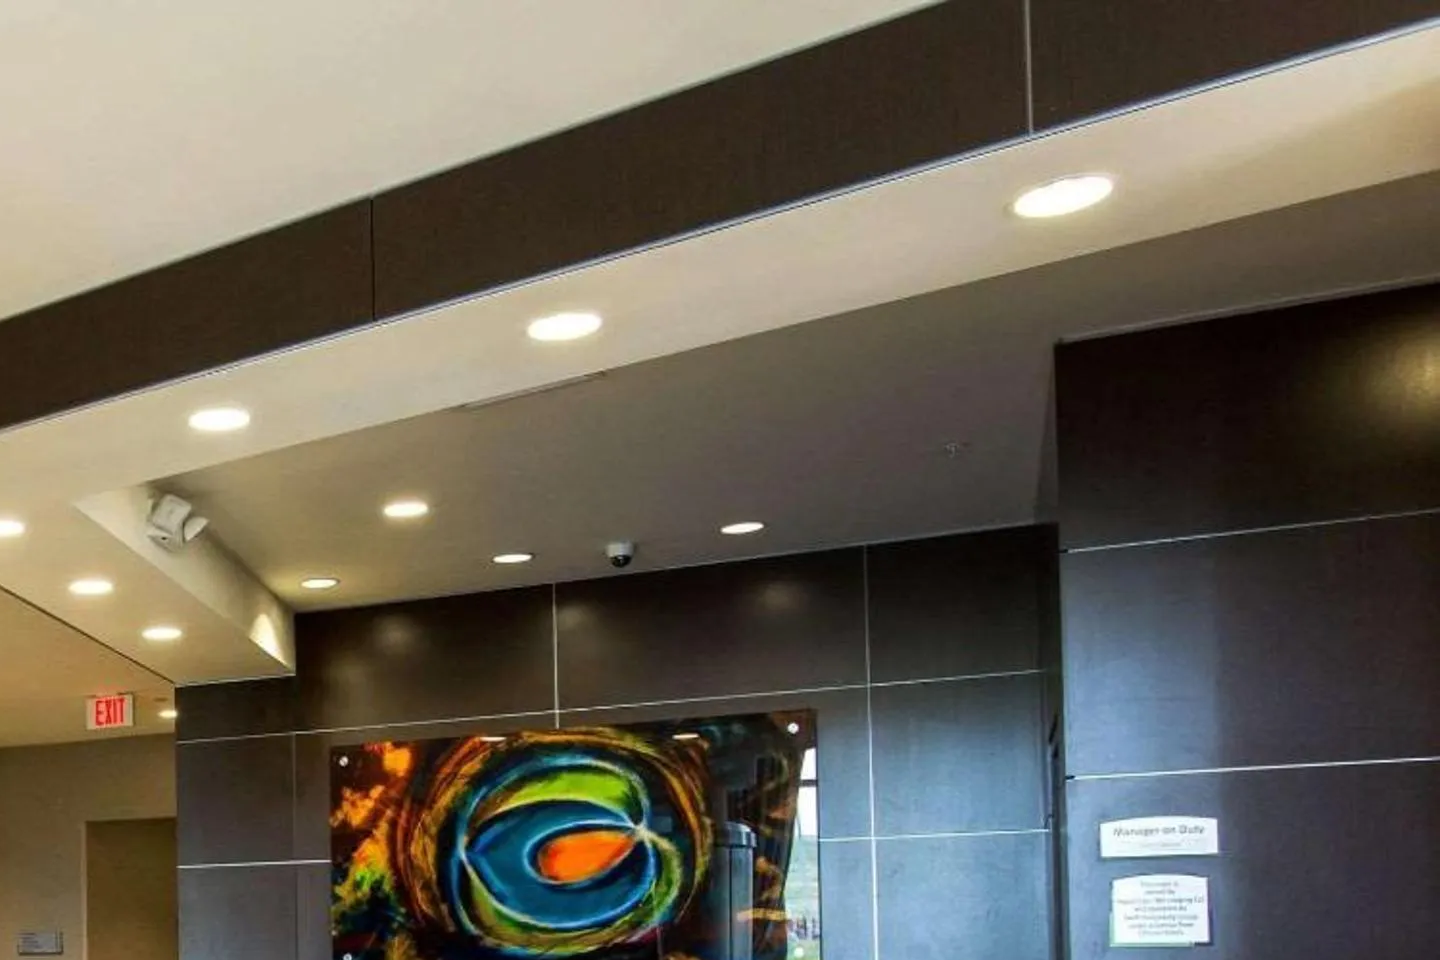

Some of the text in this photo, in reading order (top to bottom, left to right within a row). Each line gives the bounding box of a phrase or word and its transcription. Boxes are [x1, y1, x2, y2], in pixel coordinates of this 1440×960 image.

[95, 698, 124, 726] EXIT
[1113, 824, 1205, 837] Manager on Duty
